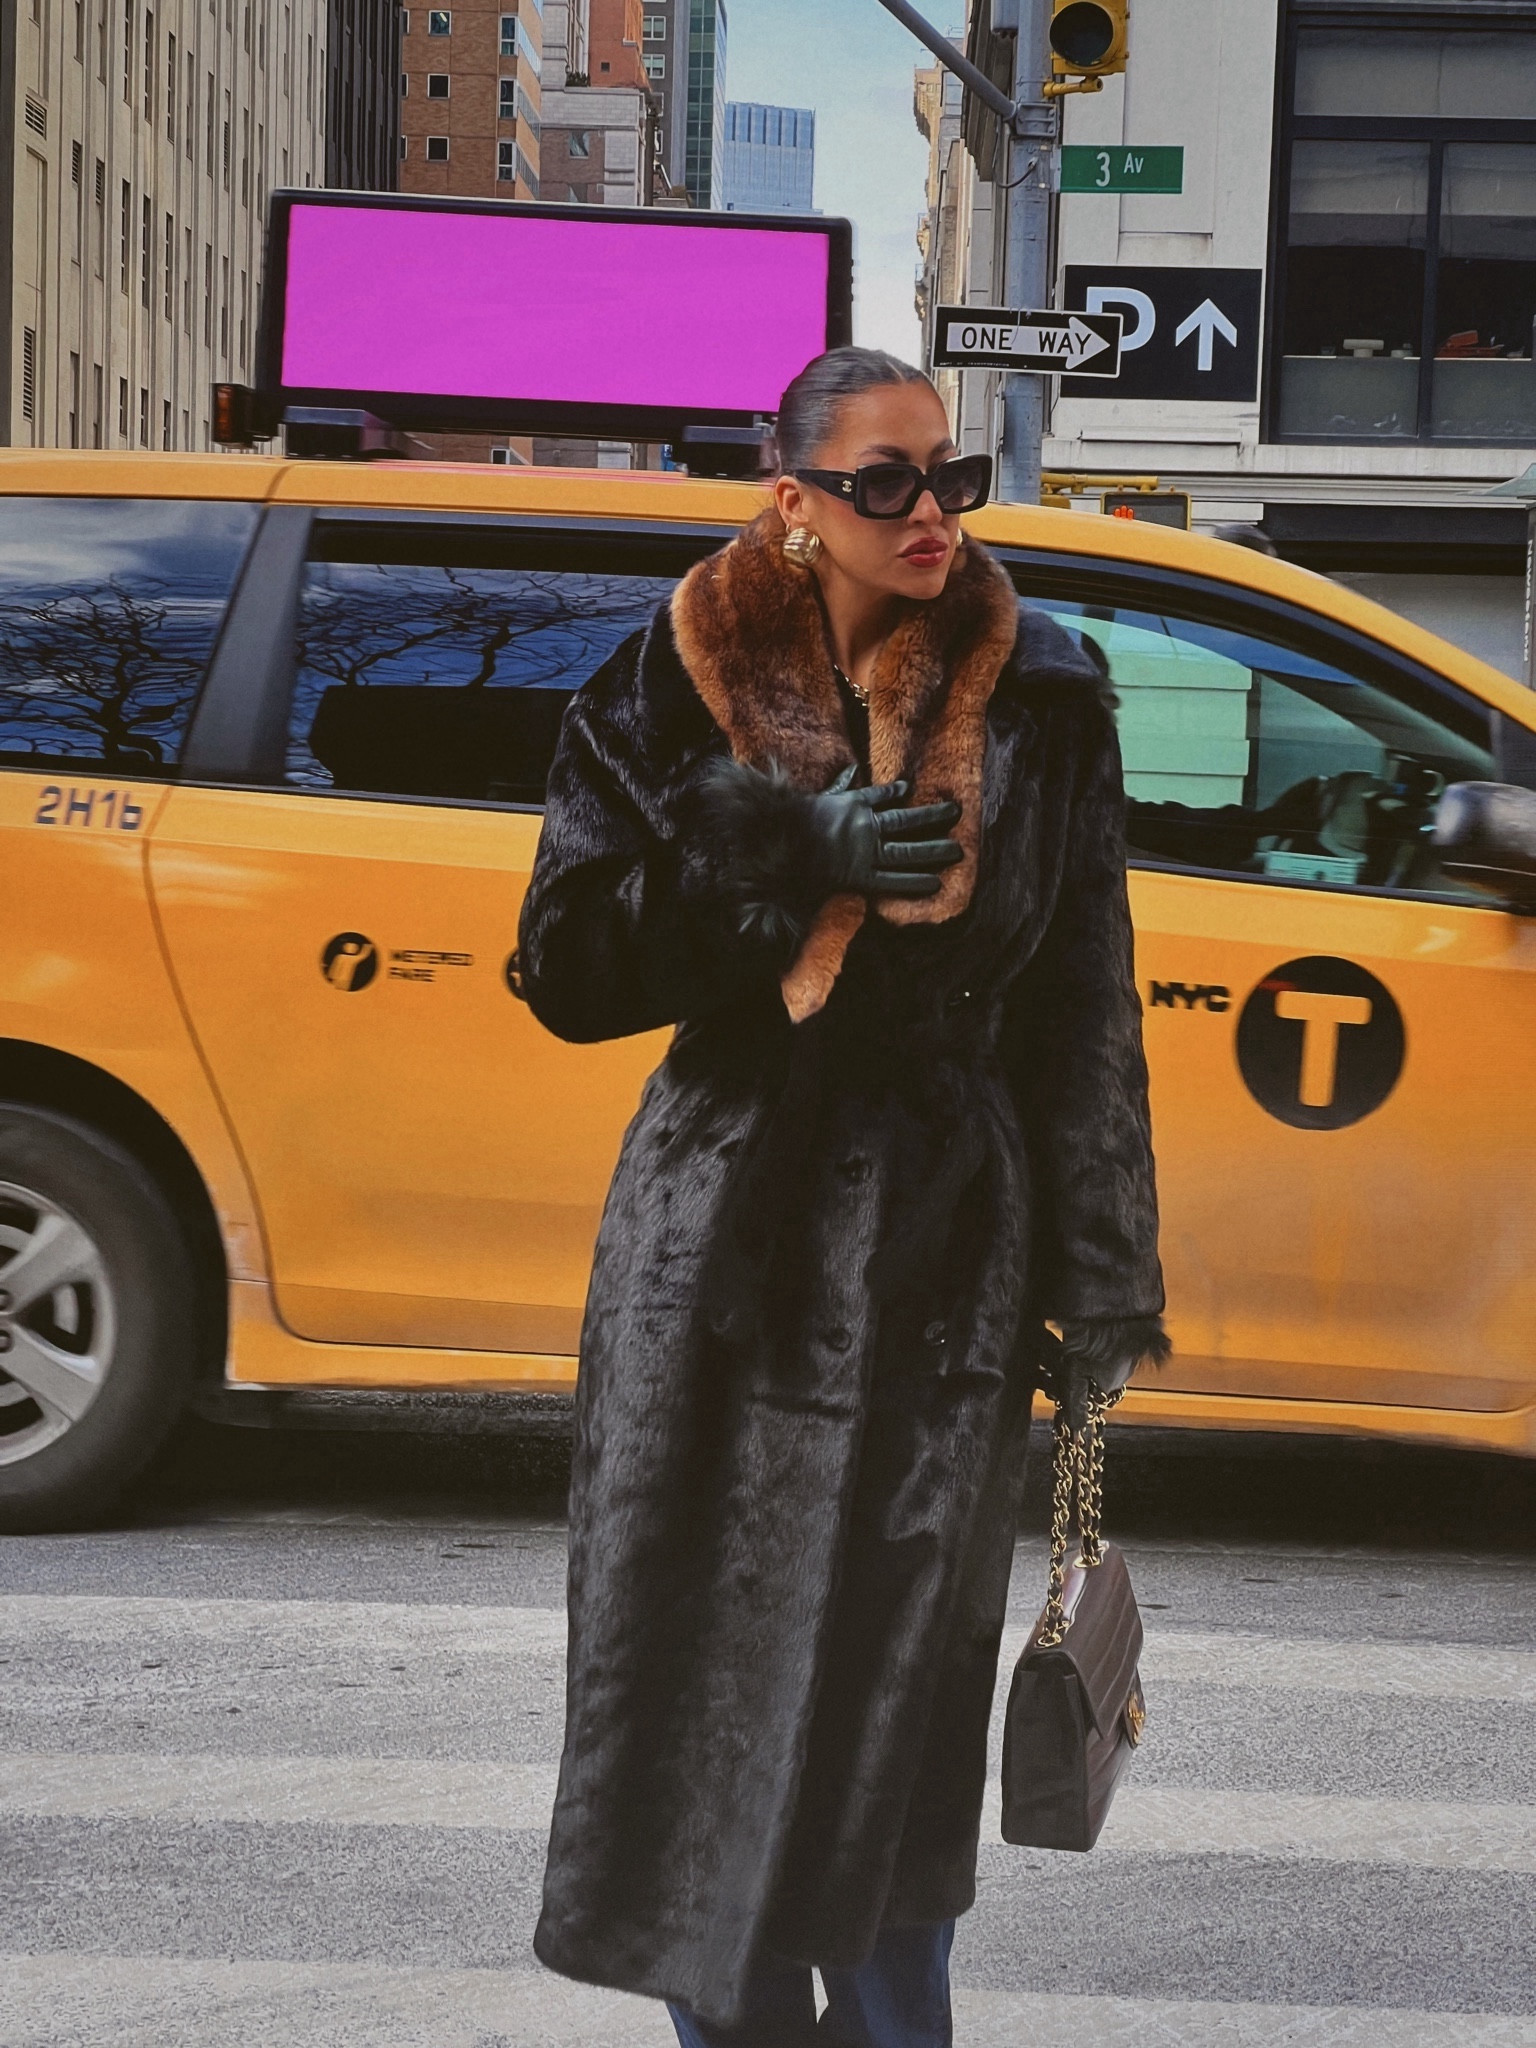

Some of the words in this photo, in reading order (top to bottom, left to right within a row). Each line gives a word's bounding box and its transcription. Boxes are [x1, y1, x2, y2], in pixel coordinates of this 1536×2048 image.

[1095, 151, 1111, 187] 3
[1123, 152, 1144, 174] Av
[961, 326, 1013, 351] ONE
[1038, 330, 1092, 355] WAY
[1149, 980, 1231, 1013] NYC
[1275, 990, 1373, 1107] T
